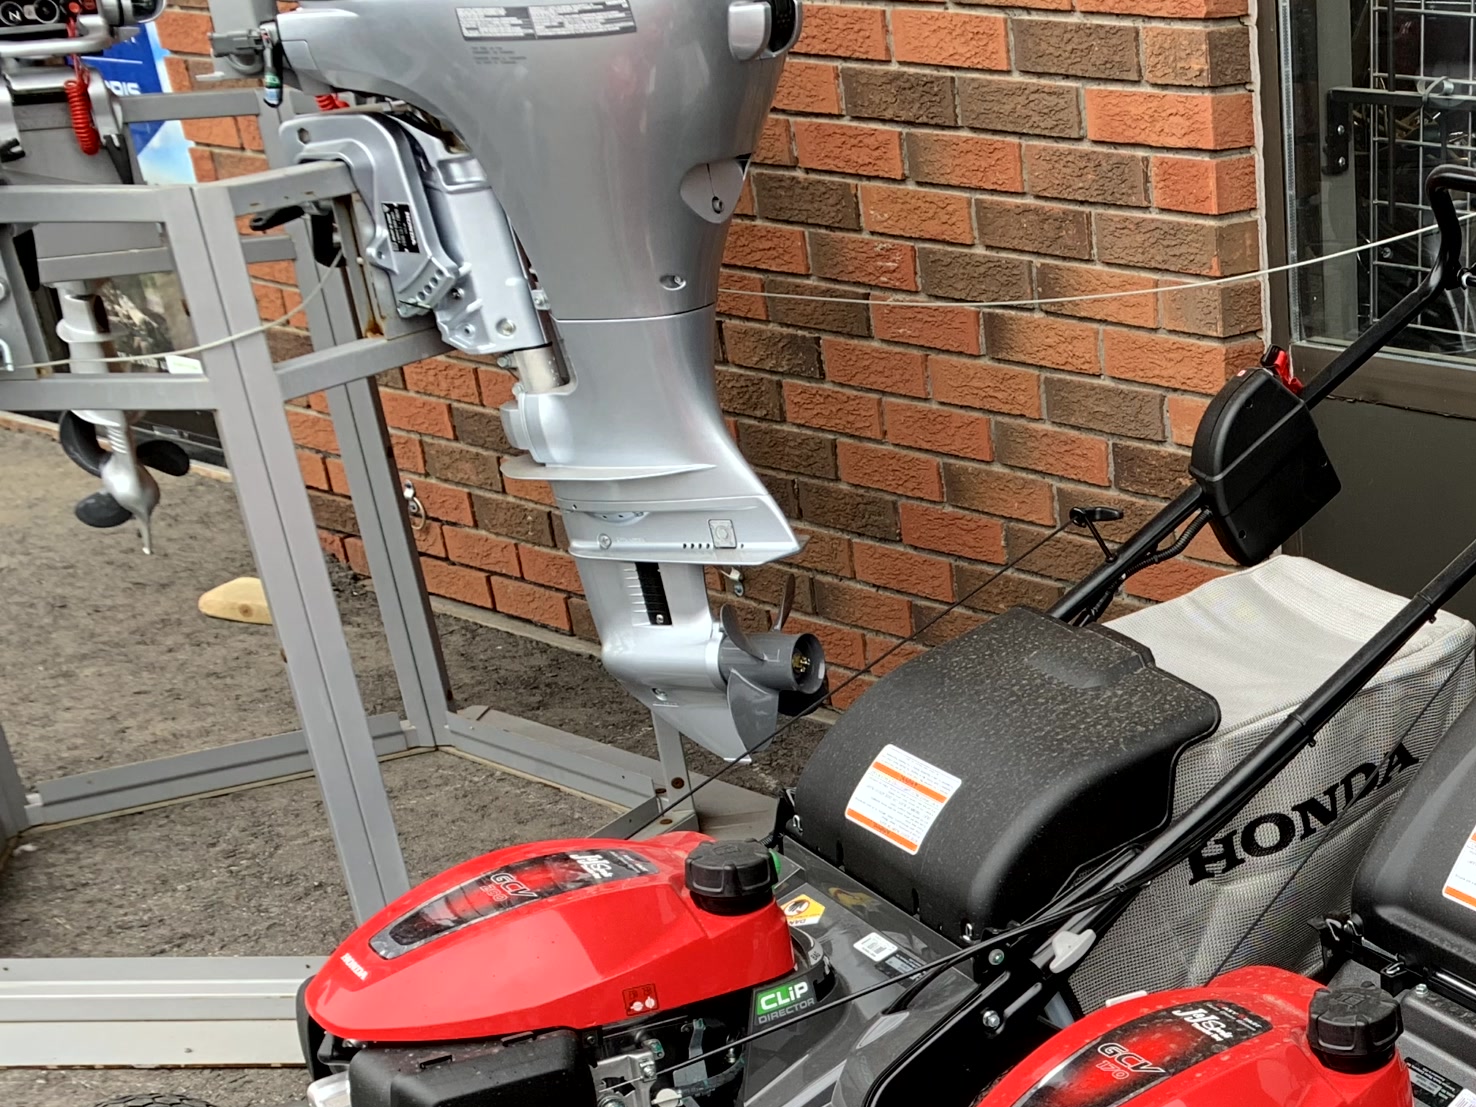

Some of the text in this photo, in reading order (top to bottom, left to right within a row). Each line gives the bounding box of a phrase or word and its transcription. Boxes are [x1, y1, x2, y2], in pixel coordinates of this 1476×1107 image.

[1188, 742, 1420, 886] HONDA
[490, 872, 538, 898] GCV
[758, 997, 815, 1024] DIRECTOR
[1096, 1060, 1130, 1080] 170
[1098, 1042, 1167, 1073] GCV
